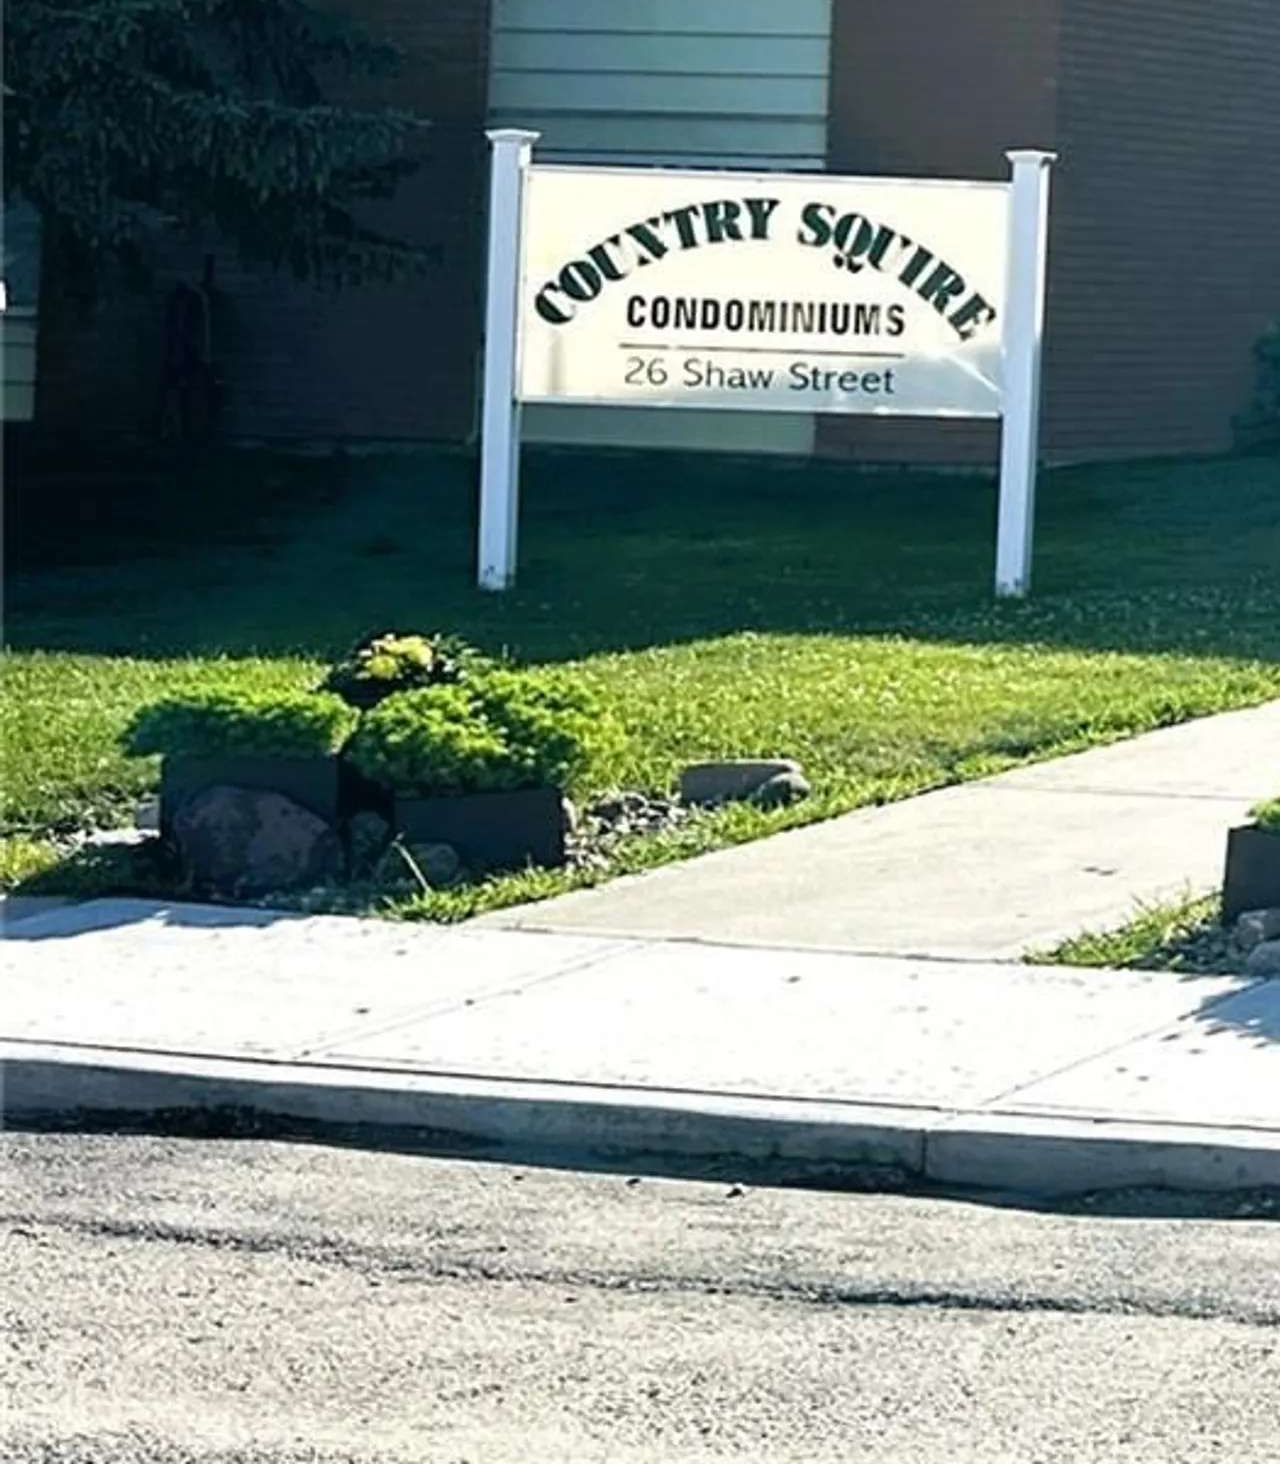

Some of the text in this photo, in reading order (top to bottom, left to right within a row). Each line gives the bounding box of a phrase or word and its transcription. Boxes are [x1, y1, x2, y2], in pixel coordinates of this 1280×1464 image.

[533, 197, 997, 341] COUNTRY SQUIRE
[625, 294, 905, 336] CONDOMINIUMS
[623, 357, 896, 394] 26 Shaw Street
